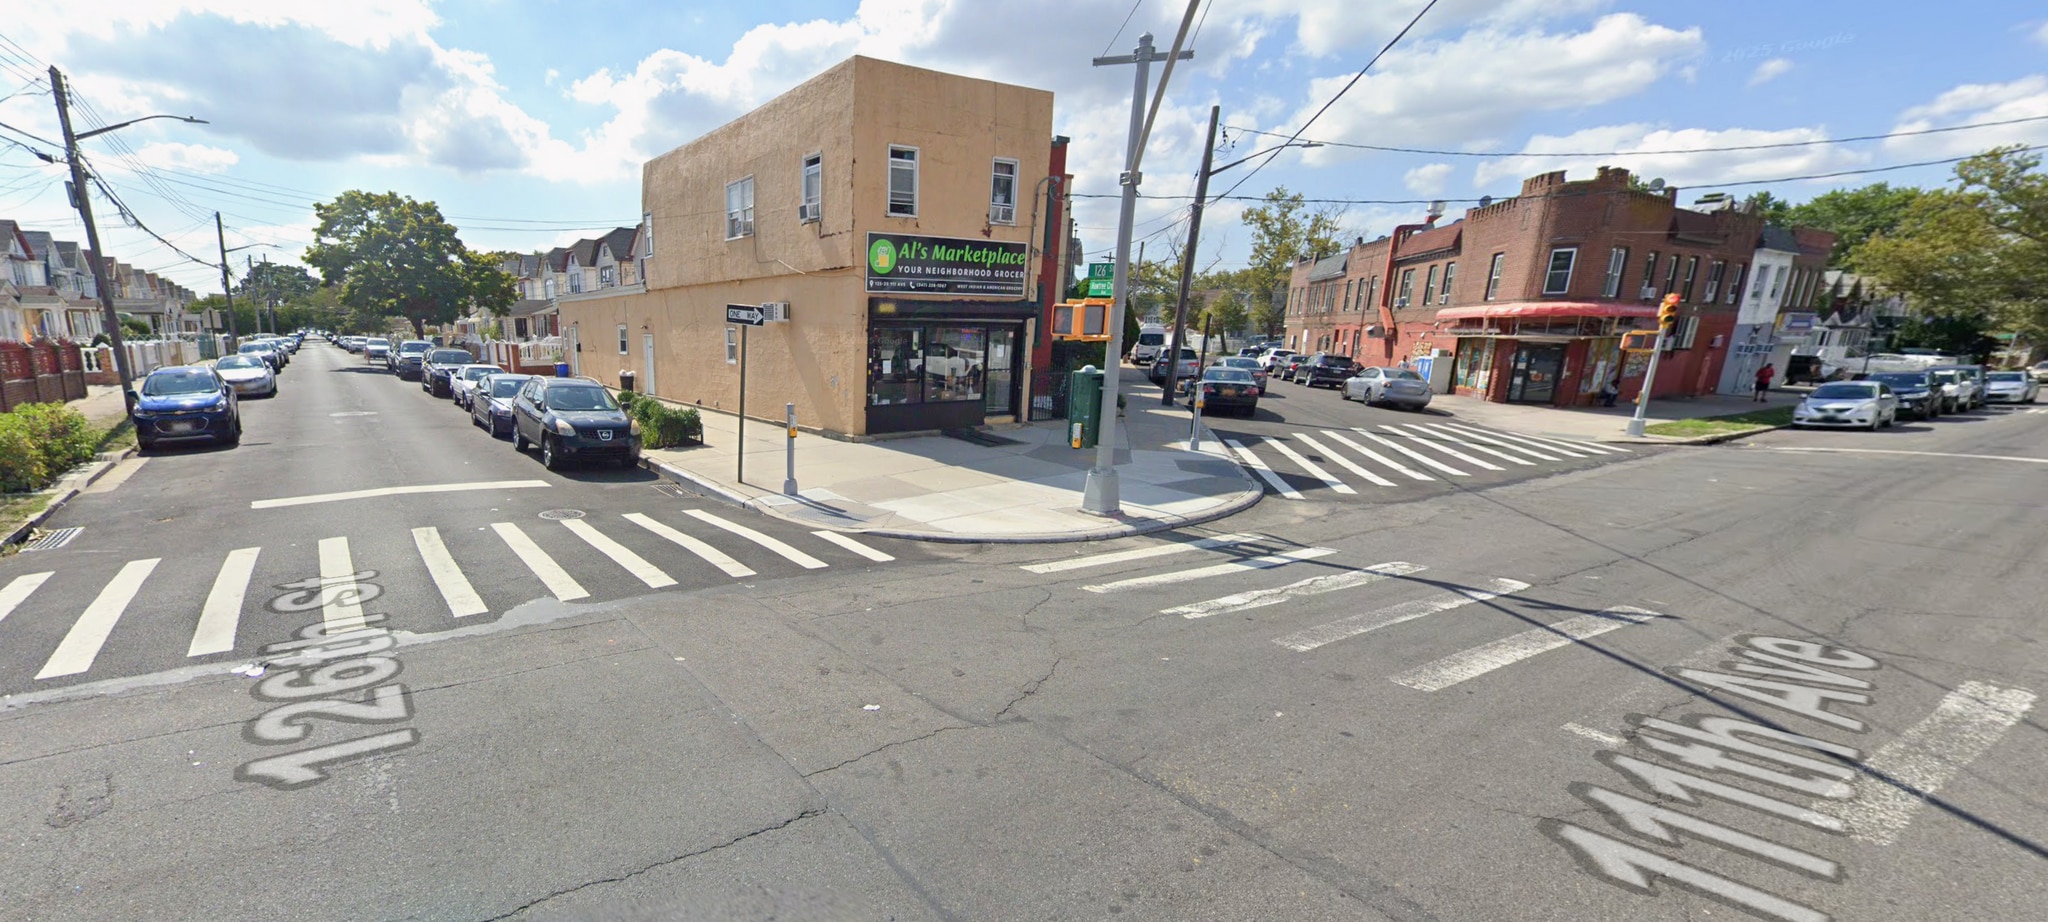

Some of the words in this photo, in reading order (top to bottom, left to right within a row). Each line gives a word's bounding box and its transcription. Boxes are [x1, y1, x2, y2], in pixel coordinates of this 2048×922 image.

[898, 241, 928, 260] Al's
[931, 244, 1025, 269] Marketplace
[897, 265, 922, 274] YOUR
[925, 266, 992, 277] NEIGHBORHOOD
[994, 269, 1025, 279] GROCER
[1095, 264, 1106, 276] 126
[729, 310, 741, 318] ONE
[746, 311, 759, 320] WAY
